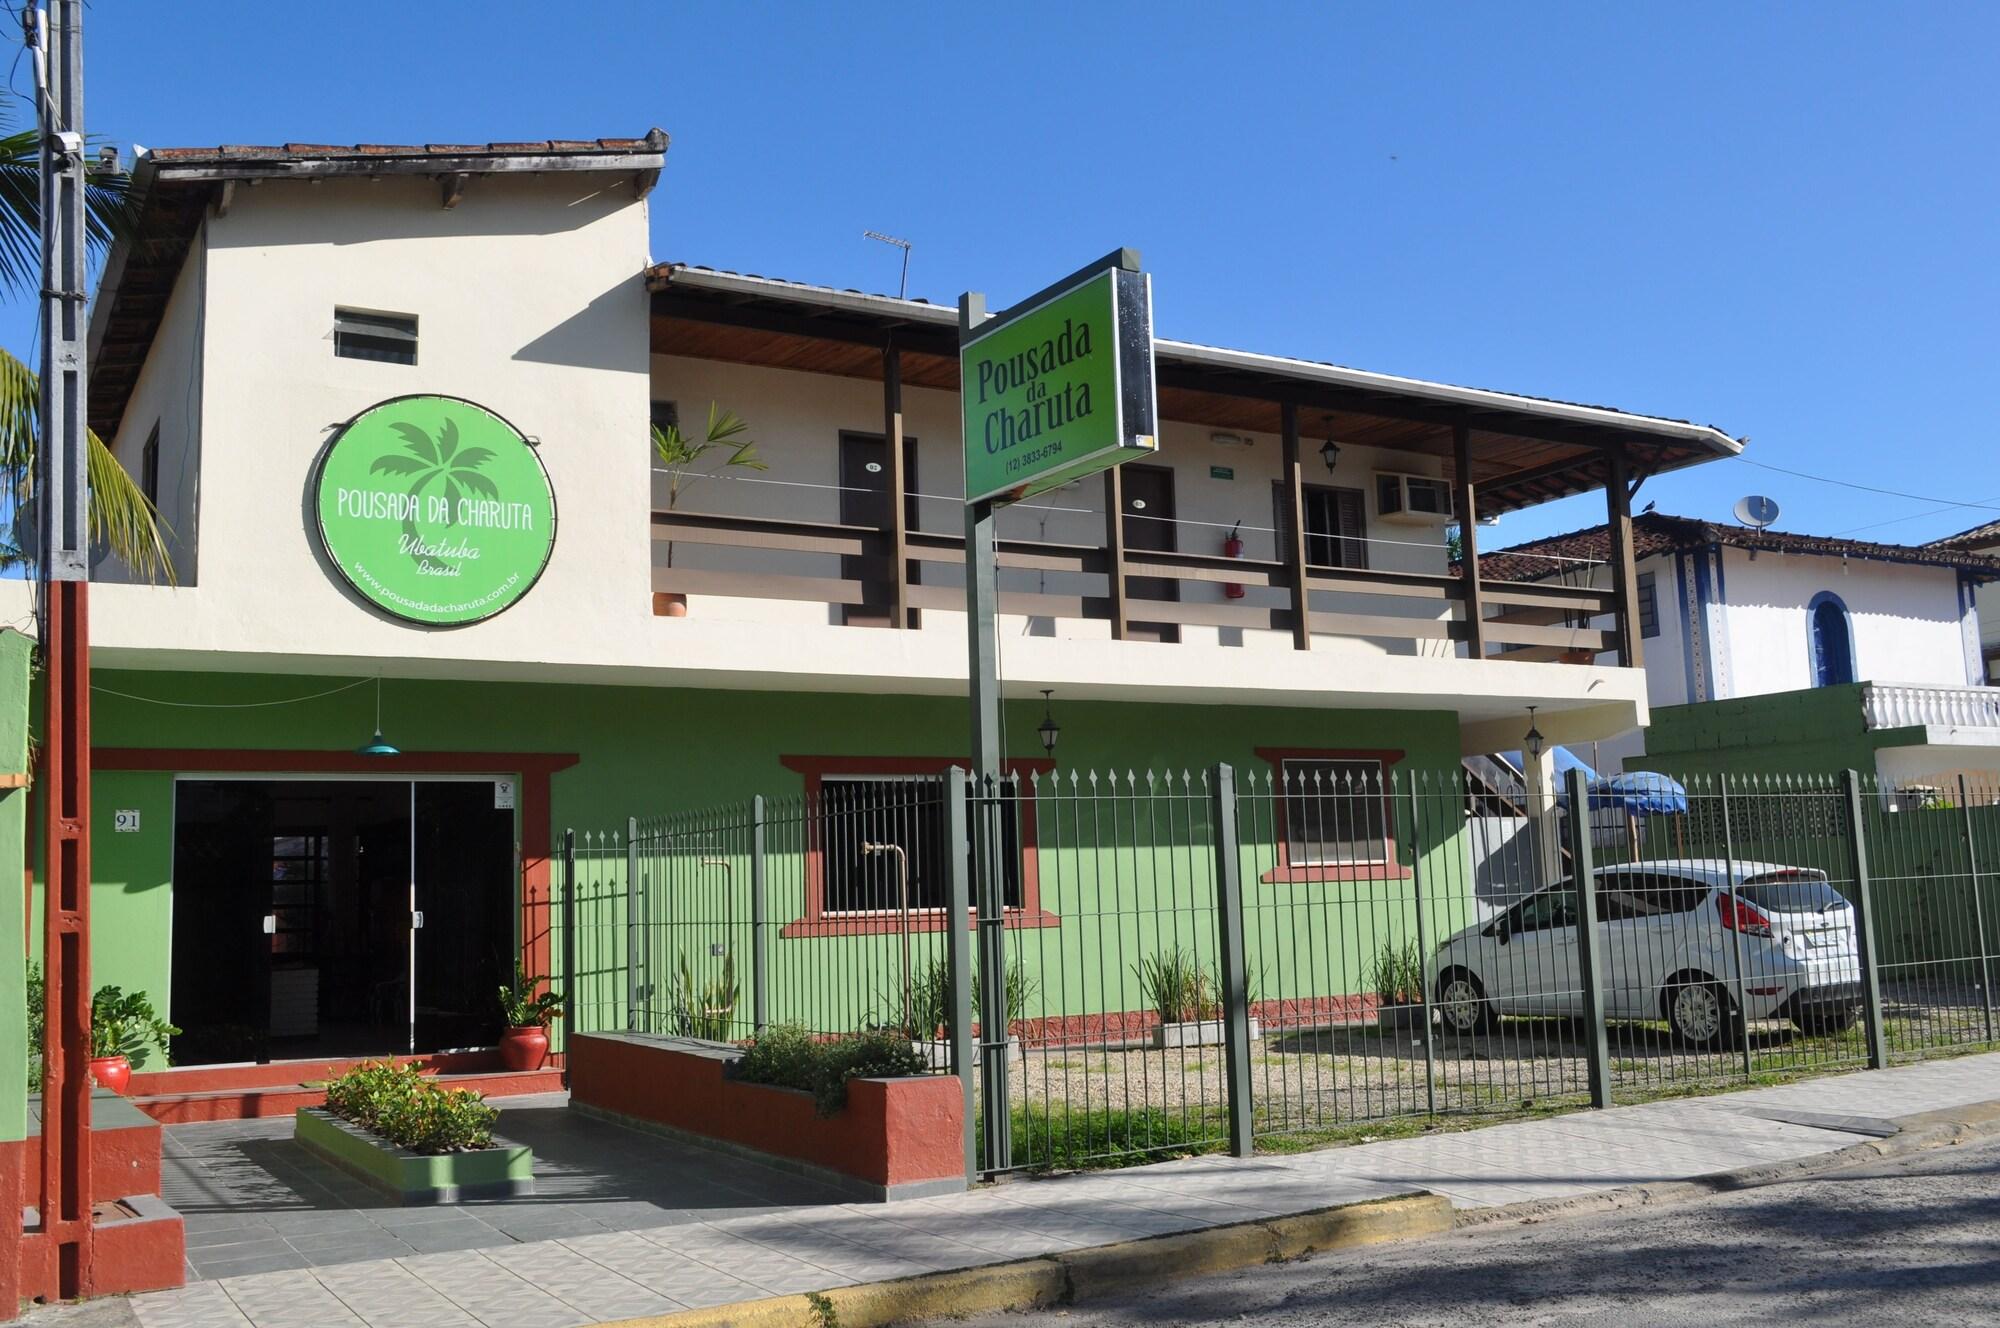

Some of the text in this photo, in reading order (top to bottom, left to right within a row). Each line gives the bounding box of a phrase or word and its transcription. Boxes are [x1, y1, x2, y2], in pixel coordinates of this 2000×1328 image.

[978, 318, 1093, 404] Pousada
[1026, 381, 1047, 403] da
[984, 381, 1093, 455] Charuta
[1005, 440, 1062, 475] (12) 3833-6794
[338, 487, 533, 531] POUSADA DA CHARUTA
[398, 533, 481, 560] Ubatuba
[416, 559, 462, 577] Brasil
[354, 561, 520, 613] www.pousadadacharuta.com.br
[116, 815, 137, 827] 91
